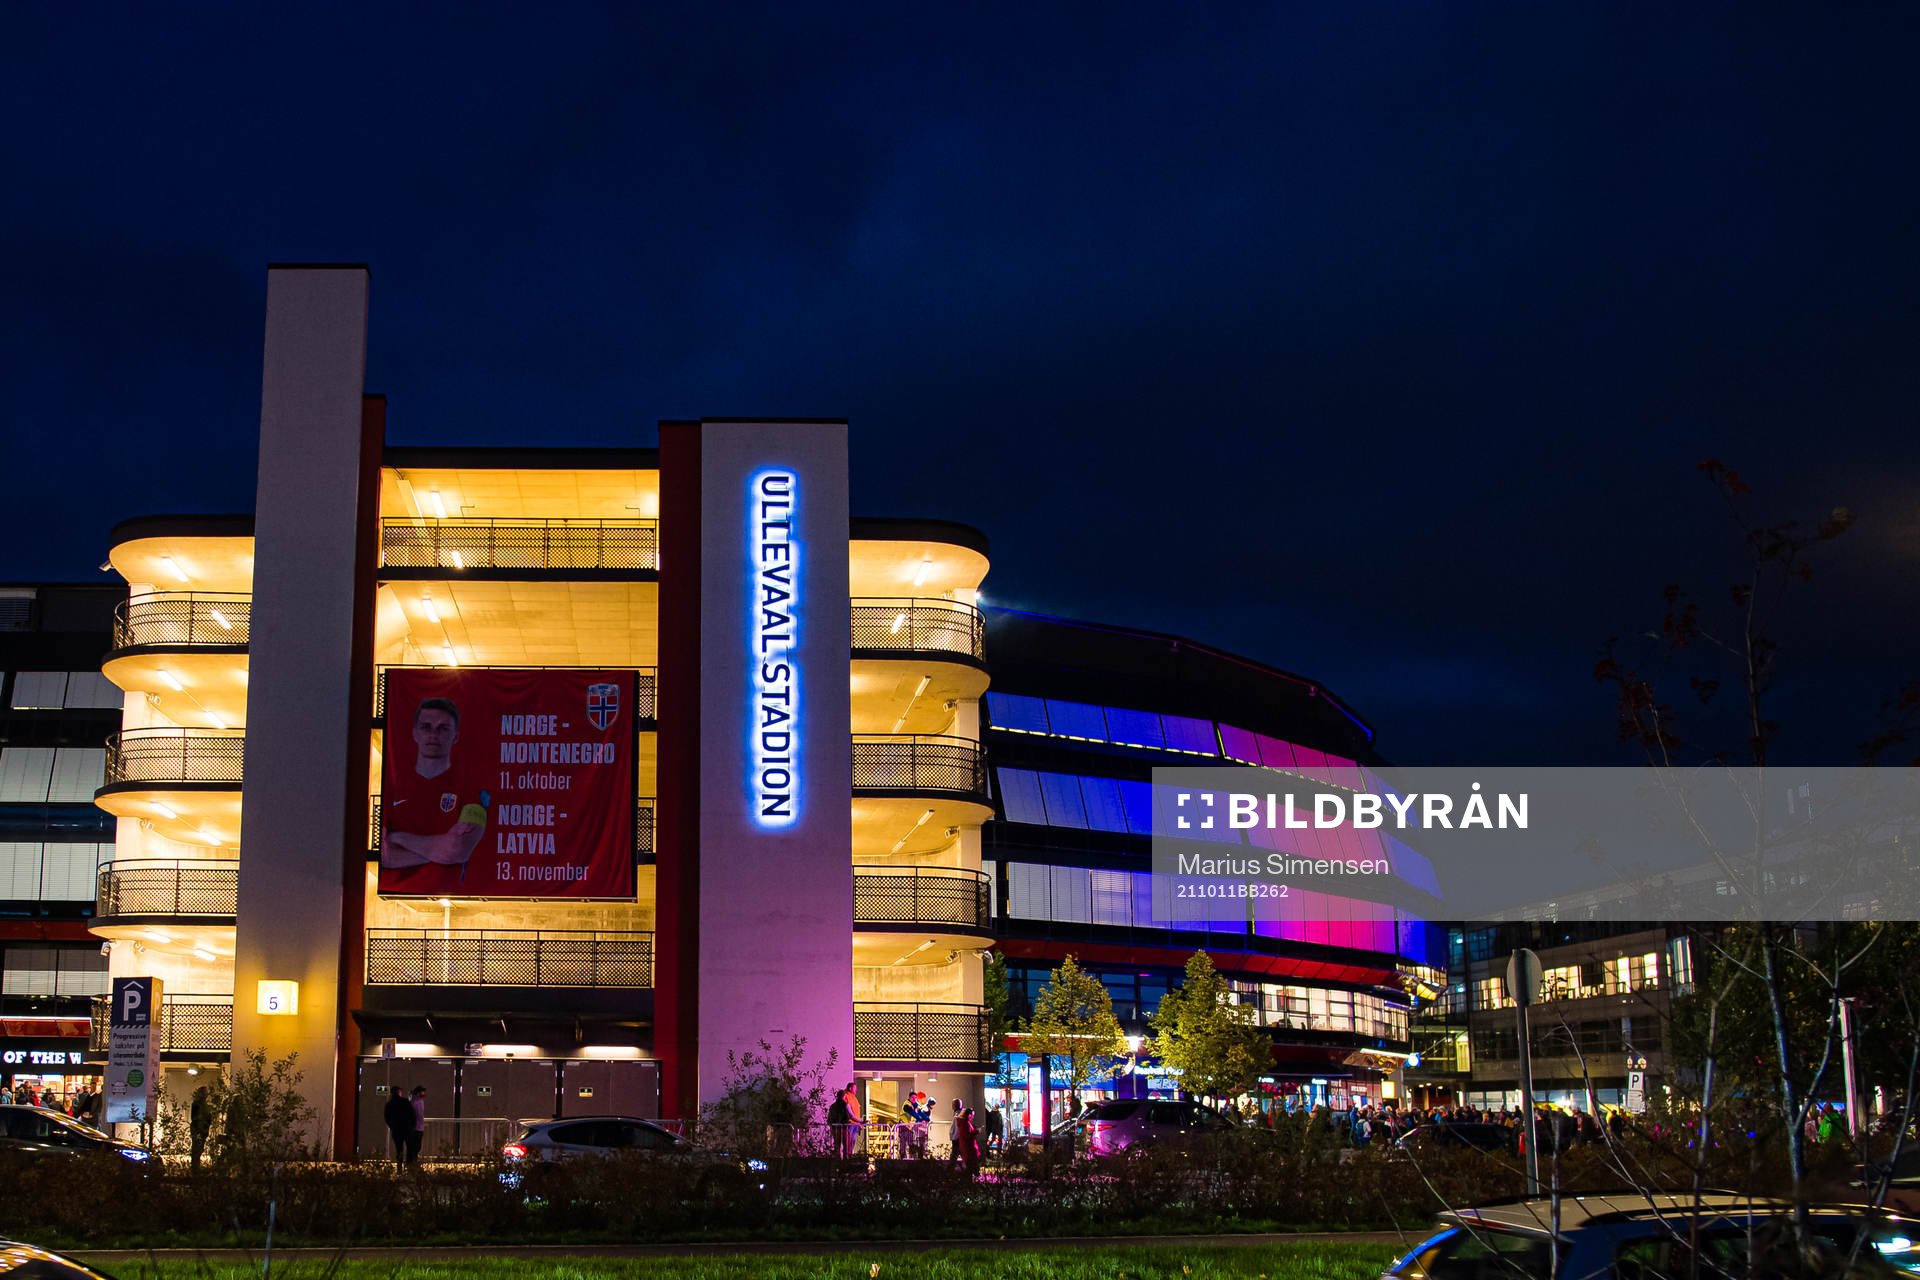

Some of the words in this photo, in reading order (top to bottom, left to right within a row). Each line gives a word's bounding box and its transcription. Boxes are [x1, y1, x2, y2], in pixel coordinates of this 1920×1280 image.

[761, 476, 791, 653] ULLEVAAL
[501, 714, 557, 736] NORGE
[761, 663, 791, 816] STADION
[500, 742, 615, 764] MONTENEGRO
[500, 772, 514, 790] 11.
[518, 772, 572, 790] oktober
[498, 804, 554, 826] NORGE
[497, 832, 556, 855] LATVIA
[496, 862, 514, 881] 13.
[519, 862, 590, 881] november
[123, 990, 142, 1021] P
[269, 996, 278, 1011] 5
[3, 1050, 26, 1064] OF
[30, 1051, 66, 1064] THE
[1631, 1074, 1640, 1088] P
